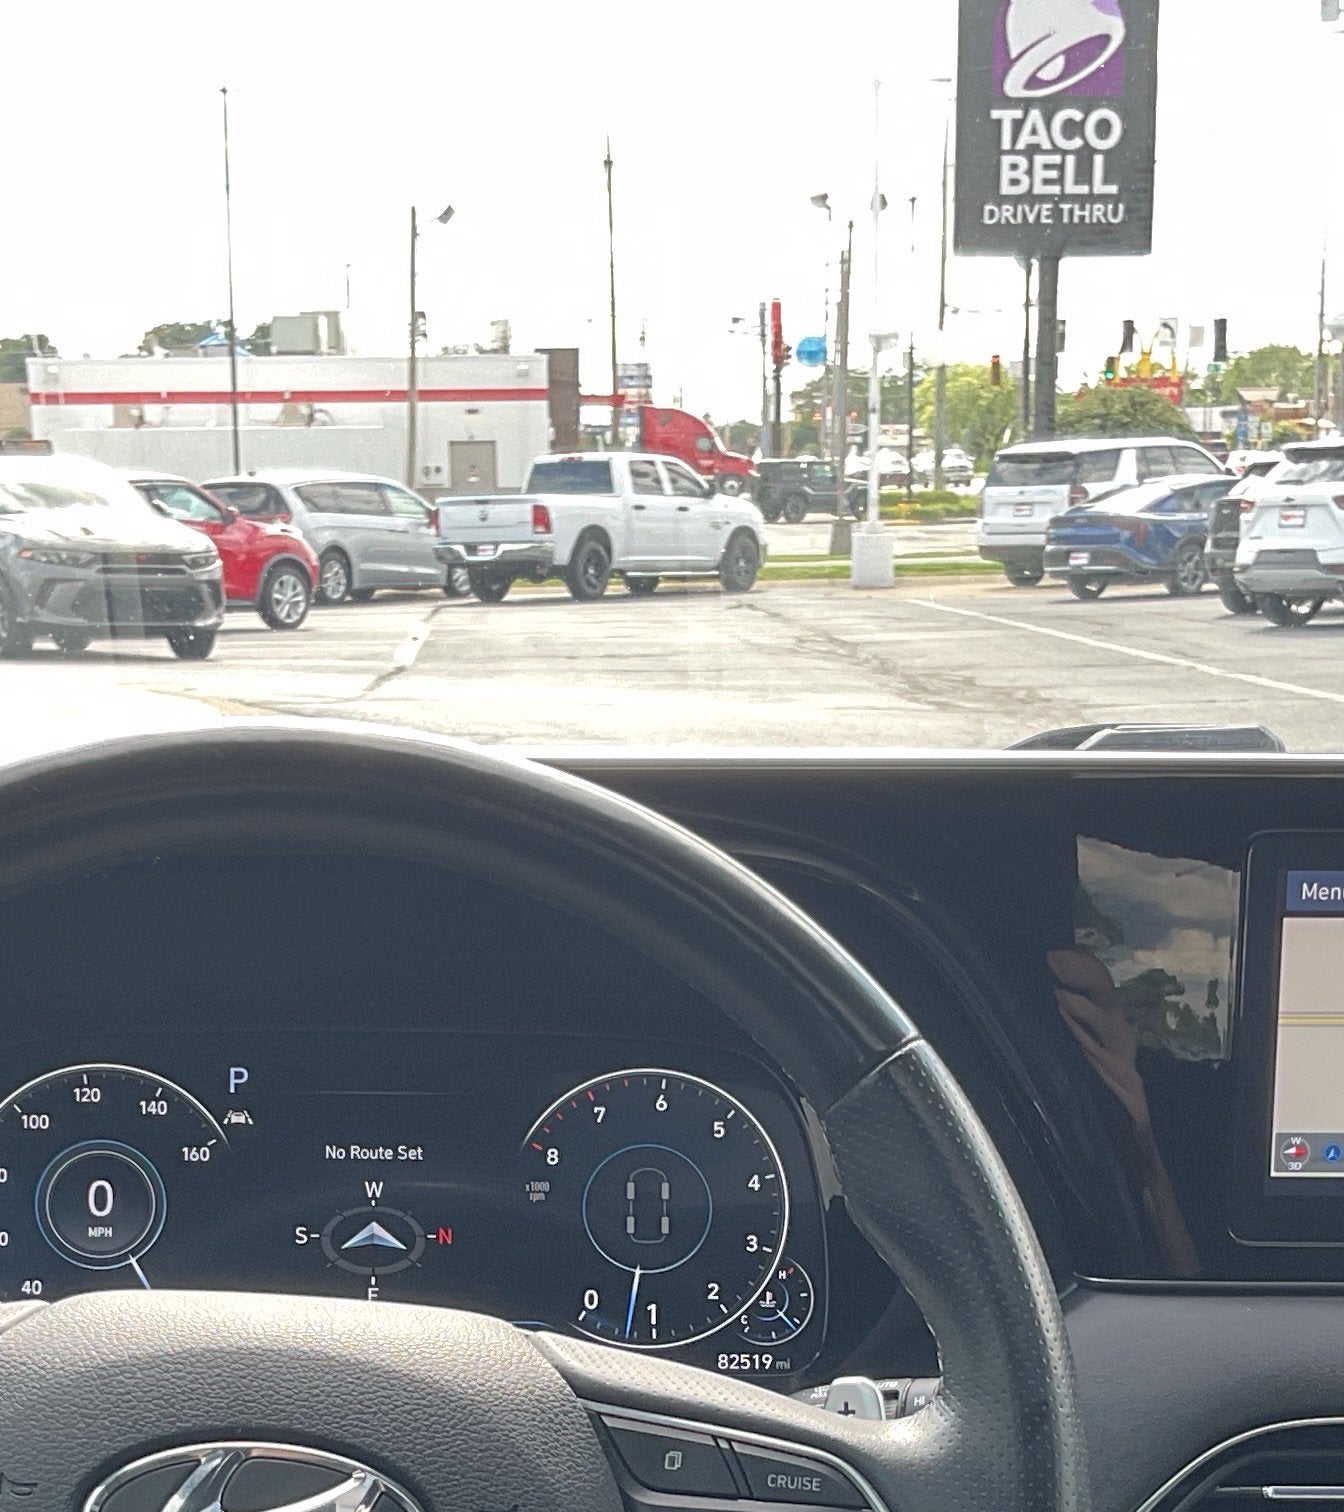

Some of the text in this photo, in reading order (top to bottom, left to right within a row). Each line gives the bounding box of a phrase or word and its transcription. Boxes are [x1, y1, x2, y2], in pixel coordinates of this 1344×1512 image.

[989, 107, 1123, 151] TACO
[998, 153, 1120, 196] BELL
[982, 202, 1126, 225] DRIVE THRU
[228, 1066, 249, 1094] P
[73, 1087, 101, 1103] 120
[655, 1095, 668, 1112] 6
[139, 1100, 168, 1116] 140
[593, 1107, 606, 1123] 7
[21, 1114, 50, 1130] 100
[712, 1122, 725, 1138] 5
[181, 1146, 211, 1162] 160
[325, 1145, 424, 1161] No Route Set
[546, 1148, 559, 1166] 8
[364, 1181, 384, 1198] W
[747, 1175, 760, 1191] 4
[87, 1179, 115, 1218] 0
[88, 1226, 113, 1238] MPH
[294, 1226, 308, 1245] S
[437, 1226, 454, 1245] N
[745, 1235, 759, 1253] 3
[778, 1269, 787, 1280] H
[21, 1280, 43, 1296] 40
[707, 1283, 720, 1300] 2
[583, 1290, 599, 1309] 0
[646, 1303, 657, 1324] 1
[716, 1353, 791, 1370] 82519 mi
[766, 1473, 822, 1493] CRUISE
